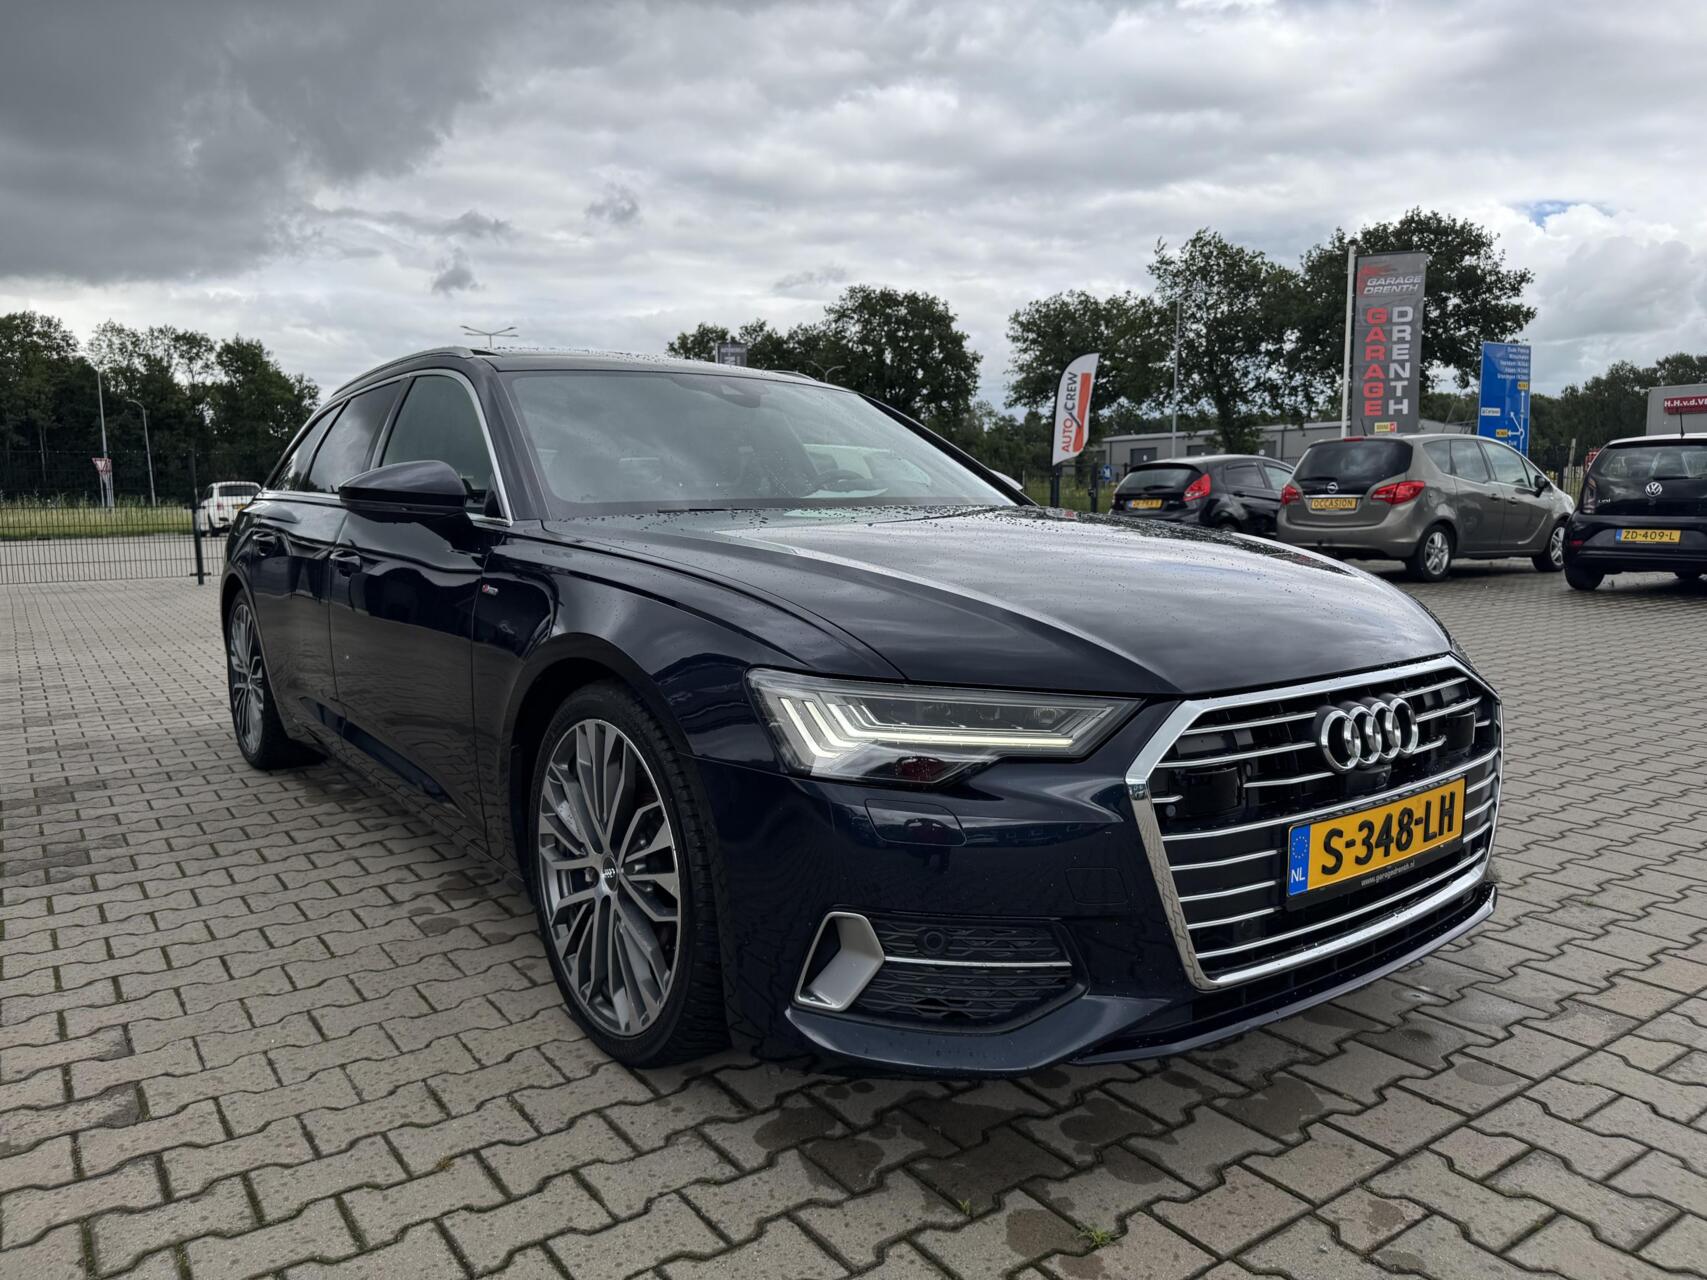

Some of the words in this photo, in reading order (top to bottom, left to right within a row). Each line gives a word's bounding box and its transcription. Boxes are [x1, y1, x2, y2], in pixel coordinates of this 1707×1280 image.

[1367, 275, 1423, 286] GARAGE
[1363, 284, 1419, 295] DRENTH
[1363, 307, 1389, 417] GARAGE
[1388, 306, 1414, 415] DRENTH
[1313, 499, 1353, 508] OCCASION
[1623, 530, 1676, 541] ZD-409-L
[1321, 790, 1456, 876] S-348-LH
[1290, 866, 1306, 883] NL
